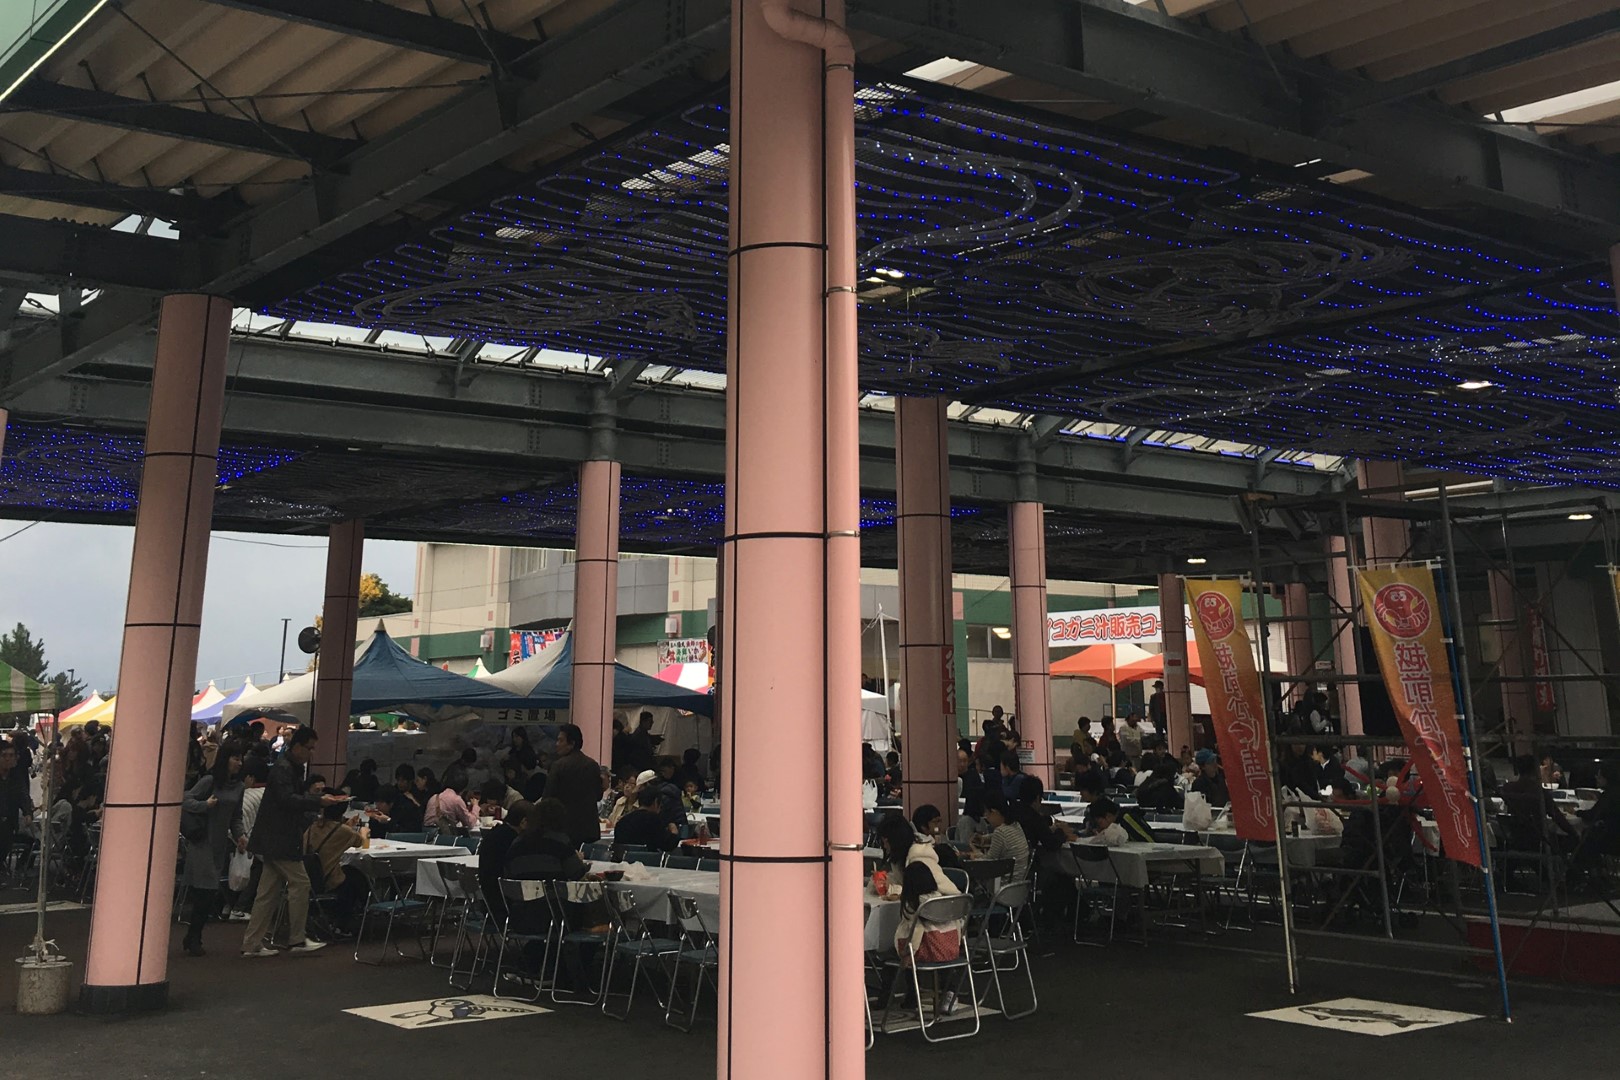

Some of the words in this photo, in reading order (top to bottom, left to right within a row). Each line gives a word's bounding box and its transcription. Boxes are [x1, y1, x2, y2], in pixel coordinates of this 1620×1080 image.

[1048, 612, 1193, 641] コガニ汁販売コ
[497, 708, 556, 721] ゴミ置場
